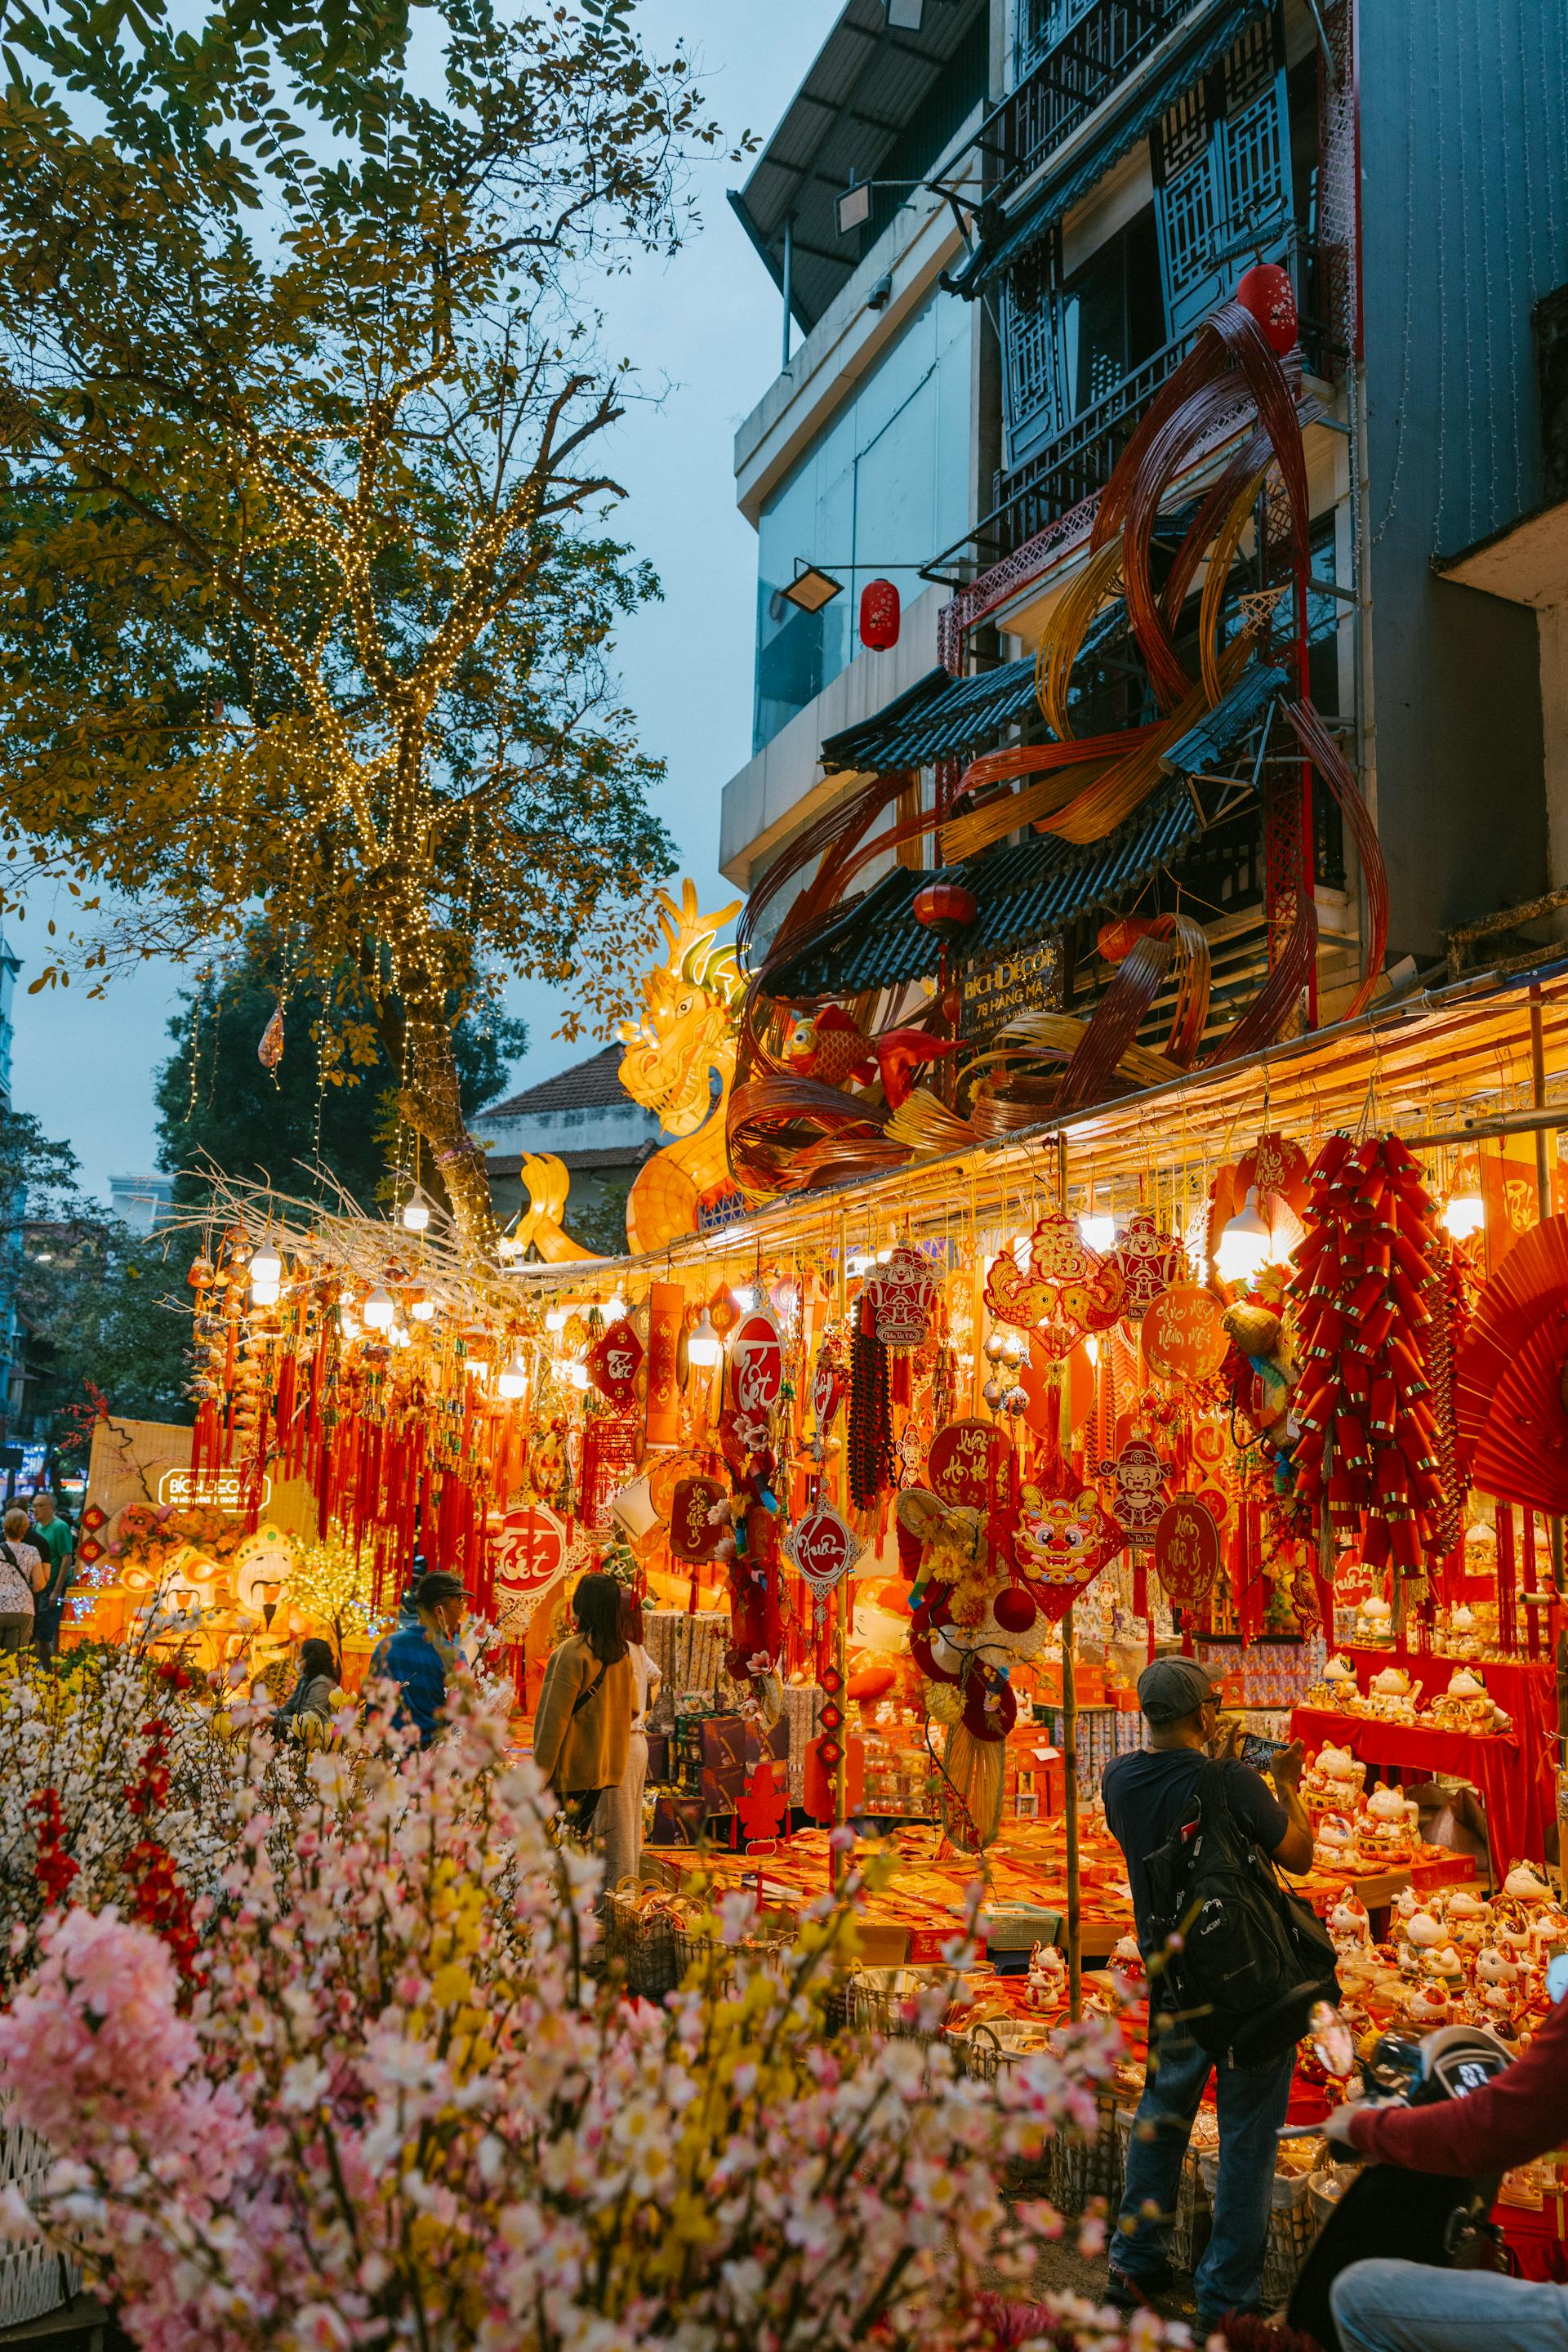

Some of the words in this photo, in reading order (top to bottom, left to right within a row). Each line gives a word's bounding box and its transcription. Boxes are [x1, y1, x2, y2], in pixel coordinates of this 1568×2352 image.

[977, 1002, 989, 1018] 78
[607, 1349, 633, 1379] Tết
[733, 1339, 781, 1412] Tết
[490, 1526, 559, 1581] Tết
[796, 1514, 846, 1577] Xuân
[1333, 1566, 1372, 1604] uân
